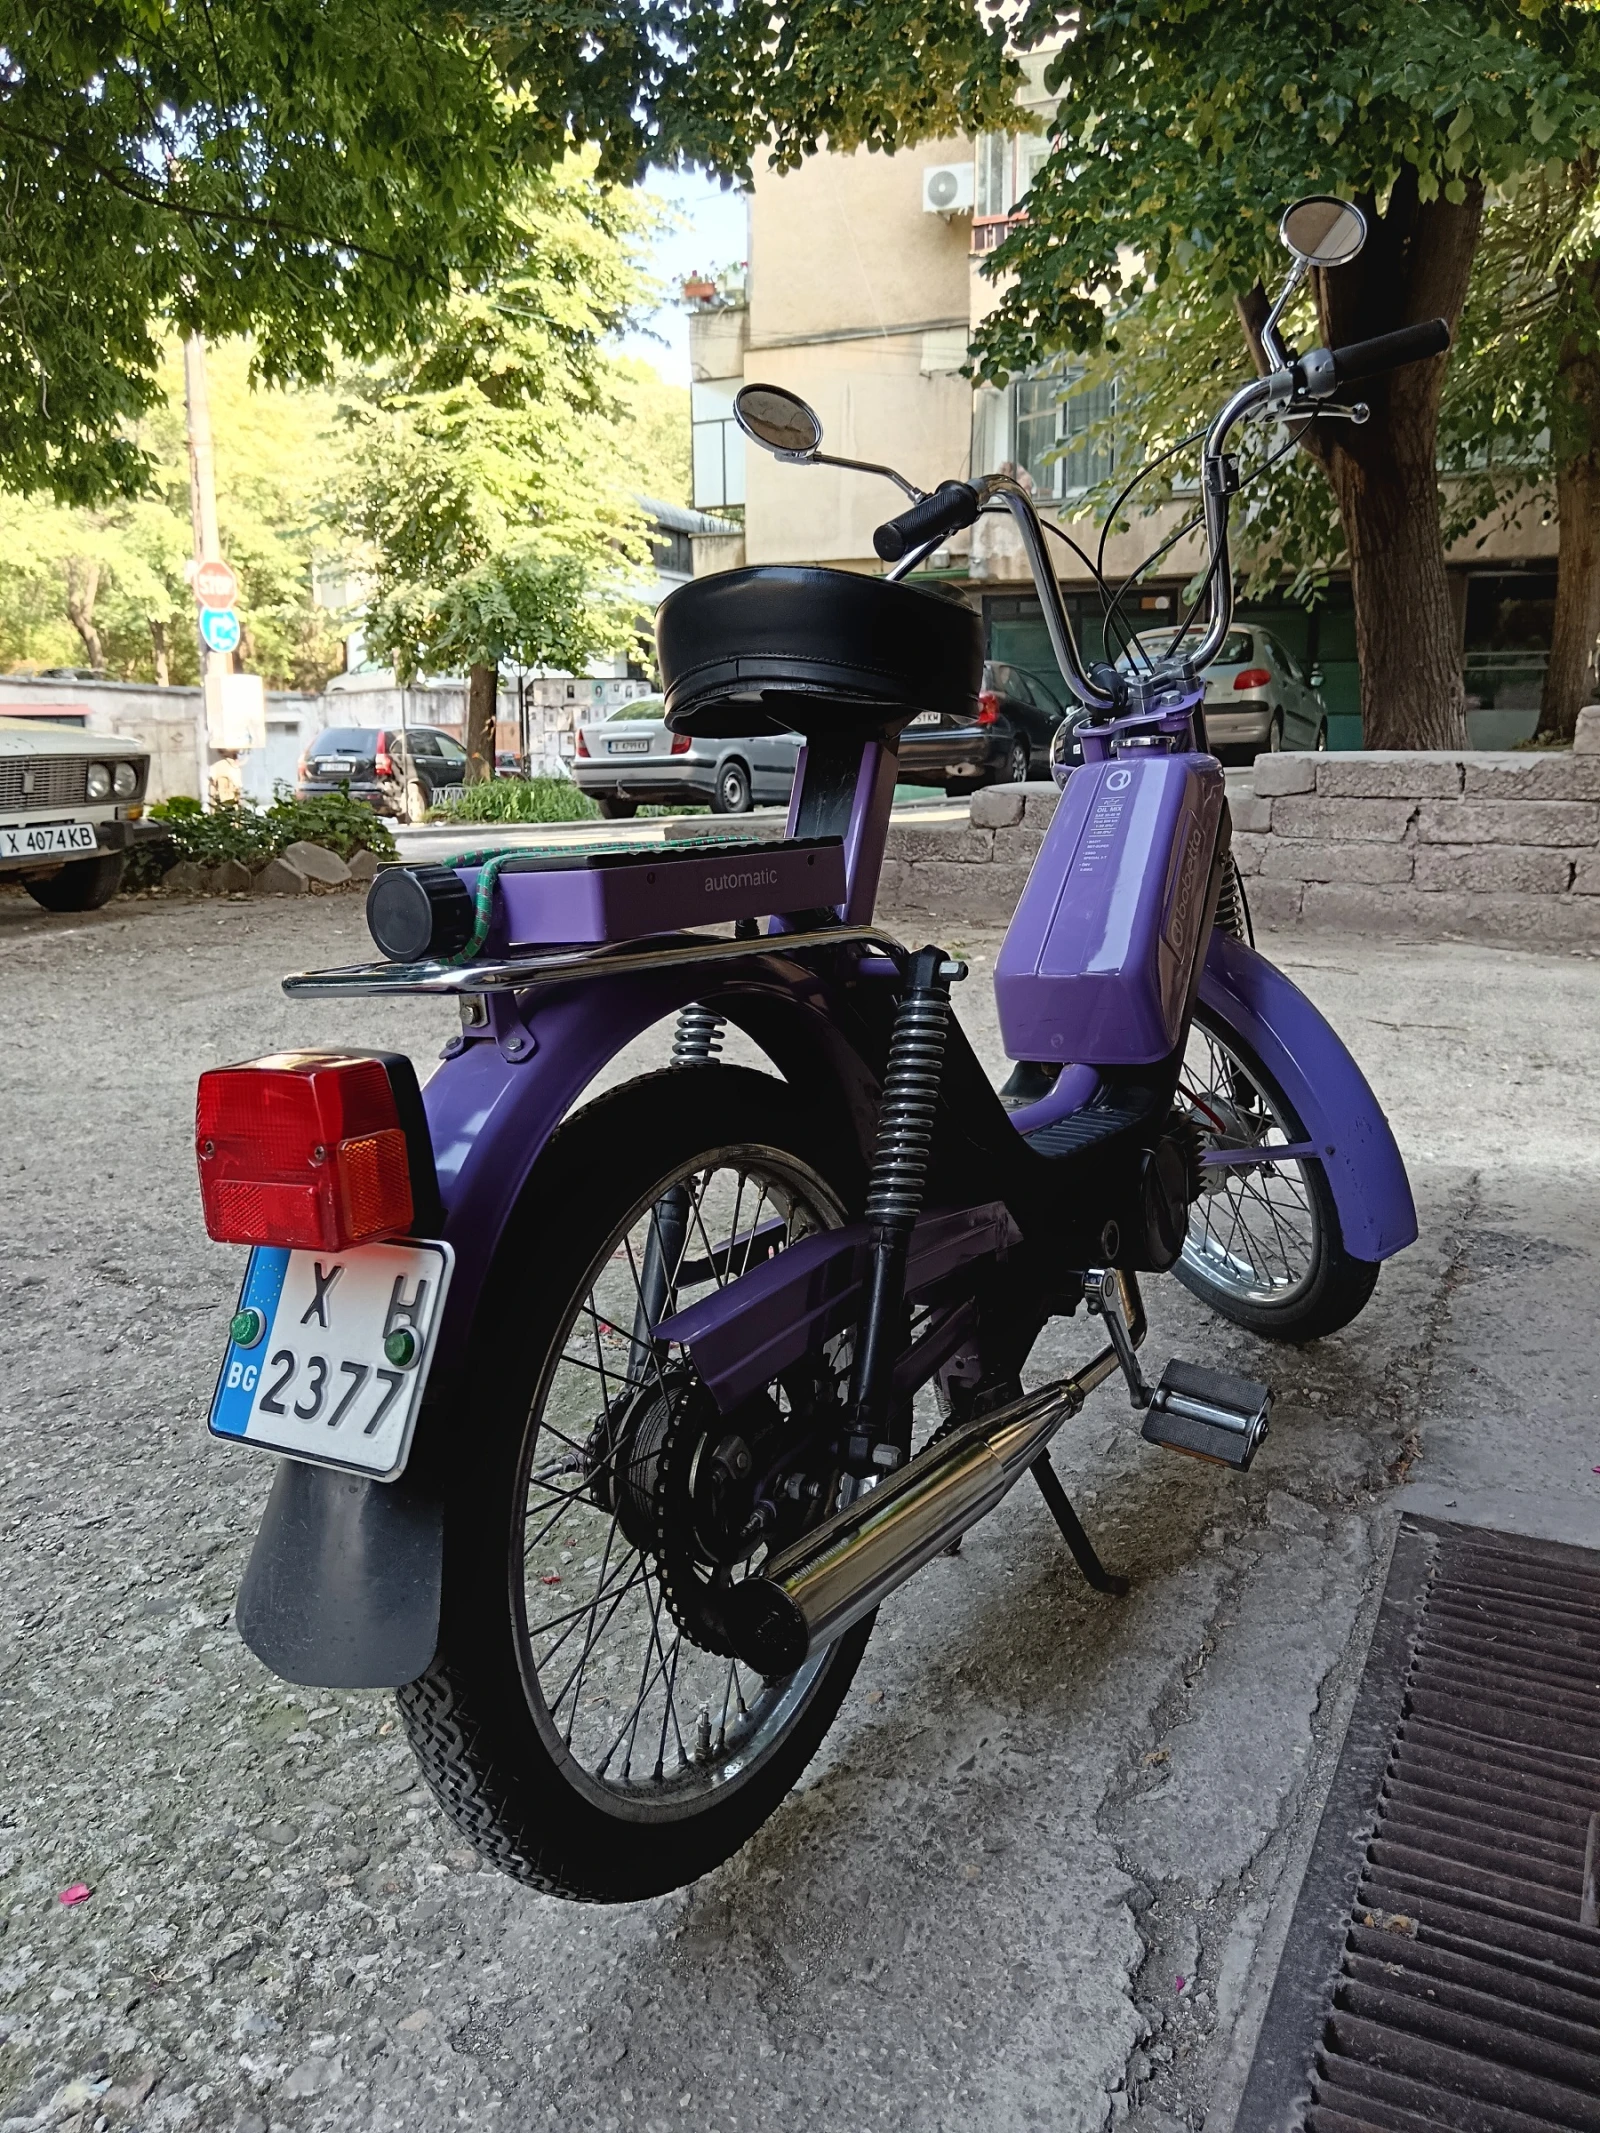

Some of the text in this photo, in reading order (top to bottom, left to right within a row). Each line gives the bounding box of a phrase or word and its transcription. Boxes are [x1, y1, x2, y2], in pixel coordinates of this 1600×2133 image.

[199, 573, 234, 595] STOP
[7, 833, 20, 853] X
[704, 868, 778, 892] automatic
[300, 1262, 342, 1328] X
[227, 1361, 258, 1392] BG
[259, 1349, 405, 1435] 2377
